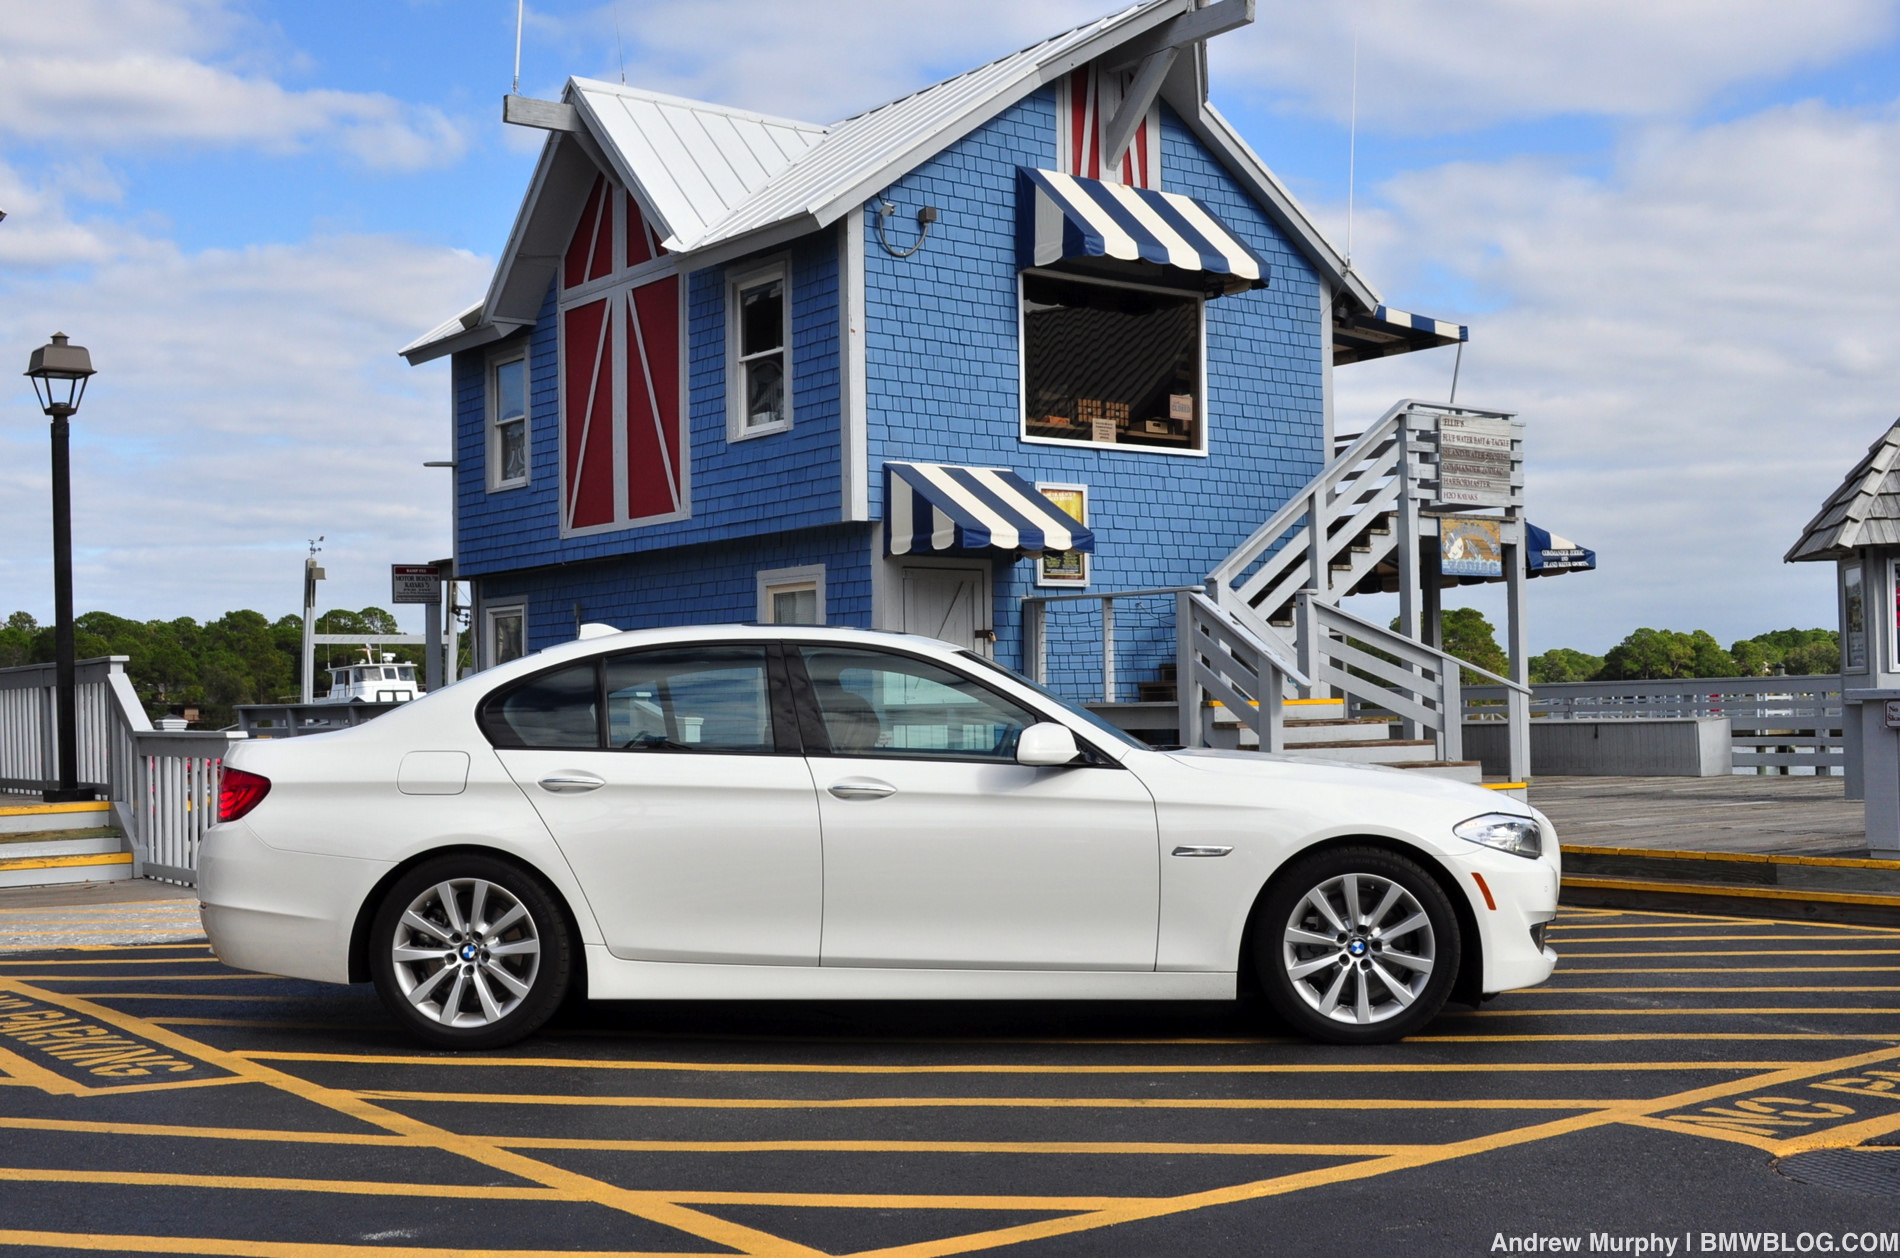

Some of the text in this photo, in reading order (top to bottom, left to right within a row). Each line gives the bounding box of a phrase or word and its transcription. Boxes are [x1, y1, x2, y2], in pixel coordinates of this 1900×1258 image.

[1443, 418, 1465, 427] ELLIE'S
[1443, 433, 1456, 442] BLUE
[1456, 435, 1473, 444] WATER
[1473, 437, 1486, 445] BAIT
[1491, 438, 1510, 447] TACKLE
[1442, 463, 1504, 475] COMMANDER ZODIAC
[1443, 477, 1490, 487] HARBORMASTER
[1457, 493, 1479, 501] KAYAKS
[1447, 560, 1499, 574] ZODIAC
[1888, 705, 1899, 713] No
[0, 1009, 194, 1077] PARKING
[1664, 1096, 1856, 1137] NO
